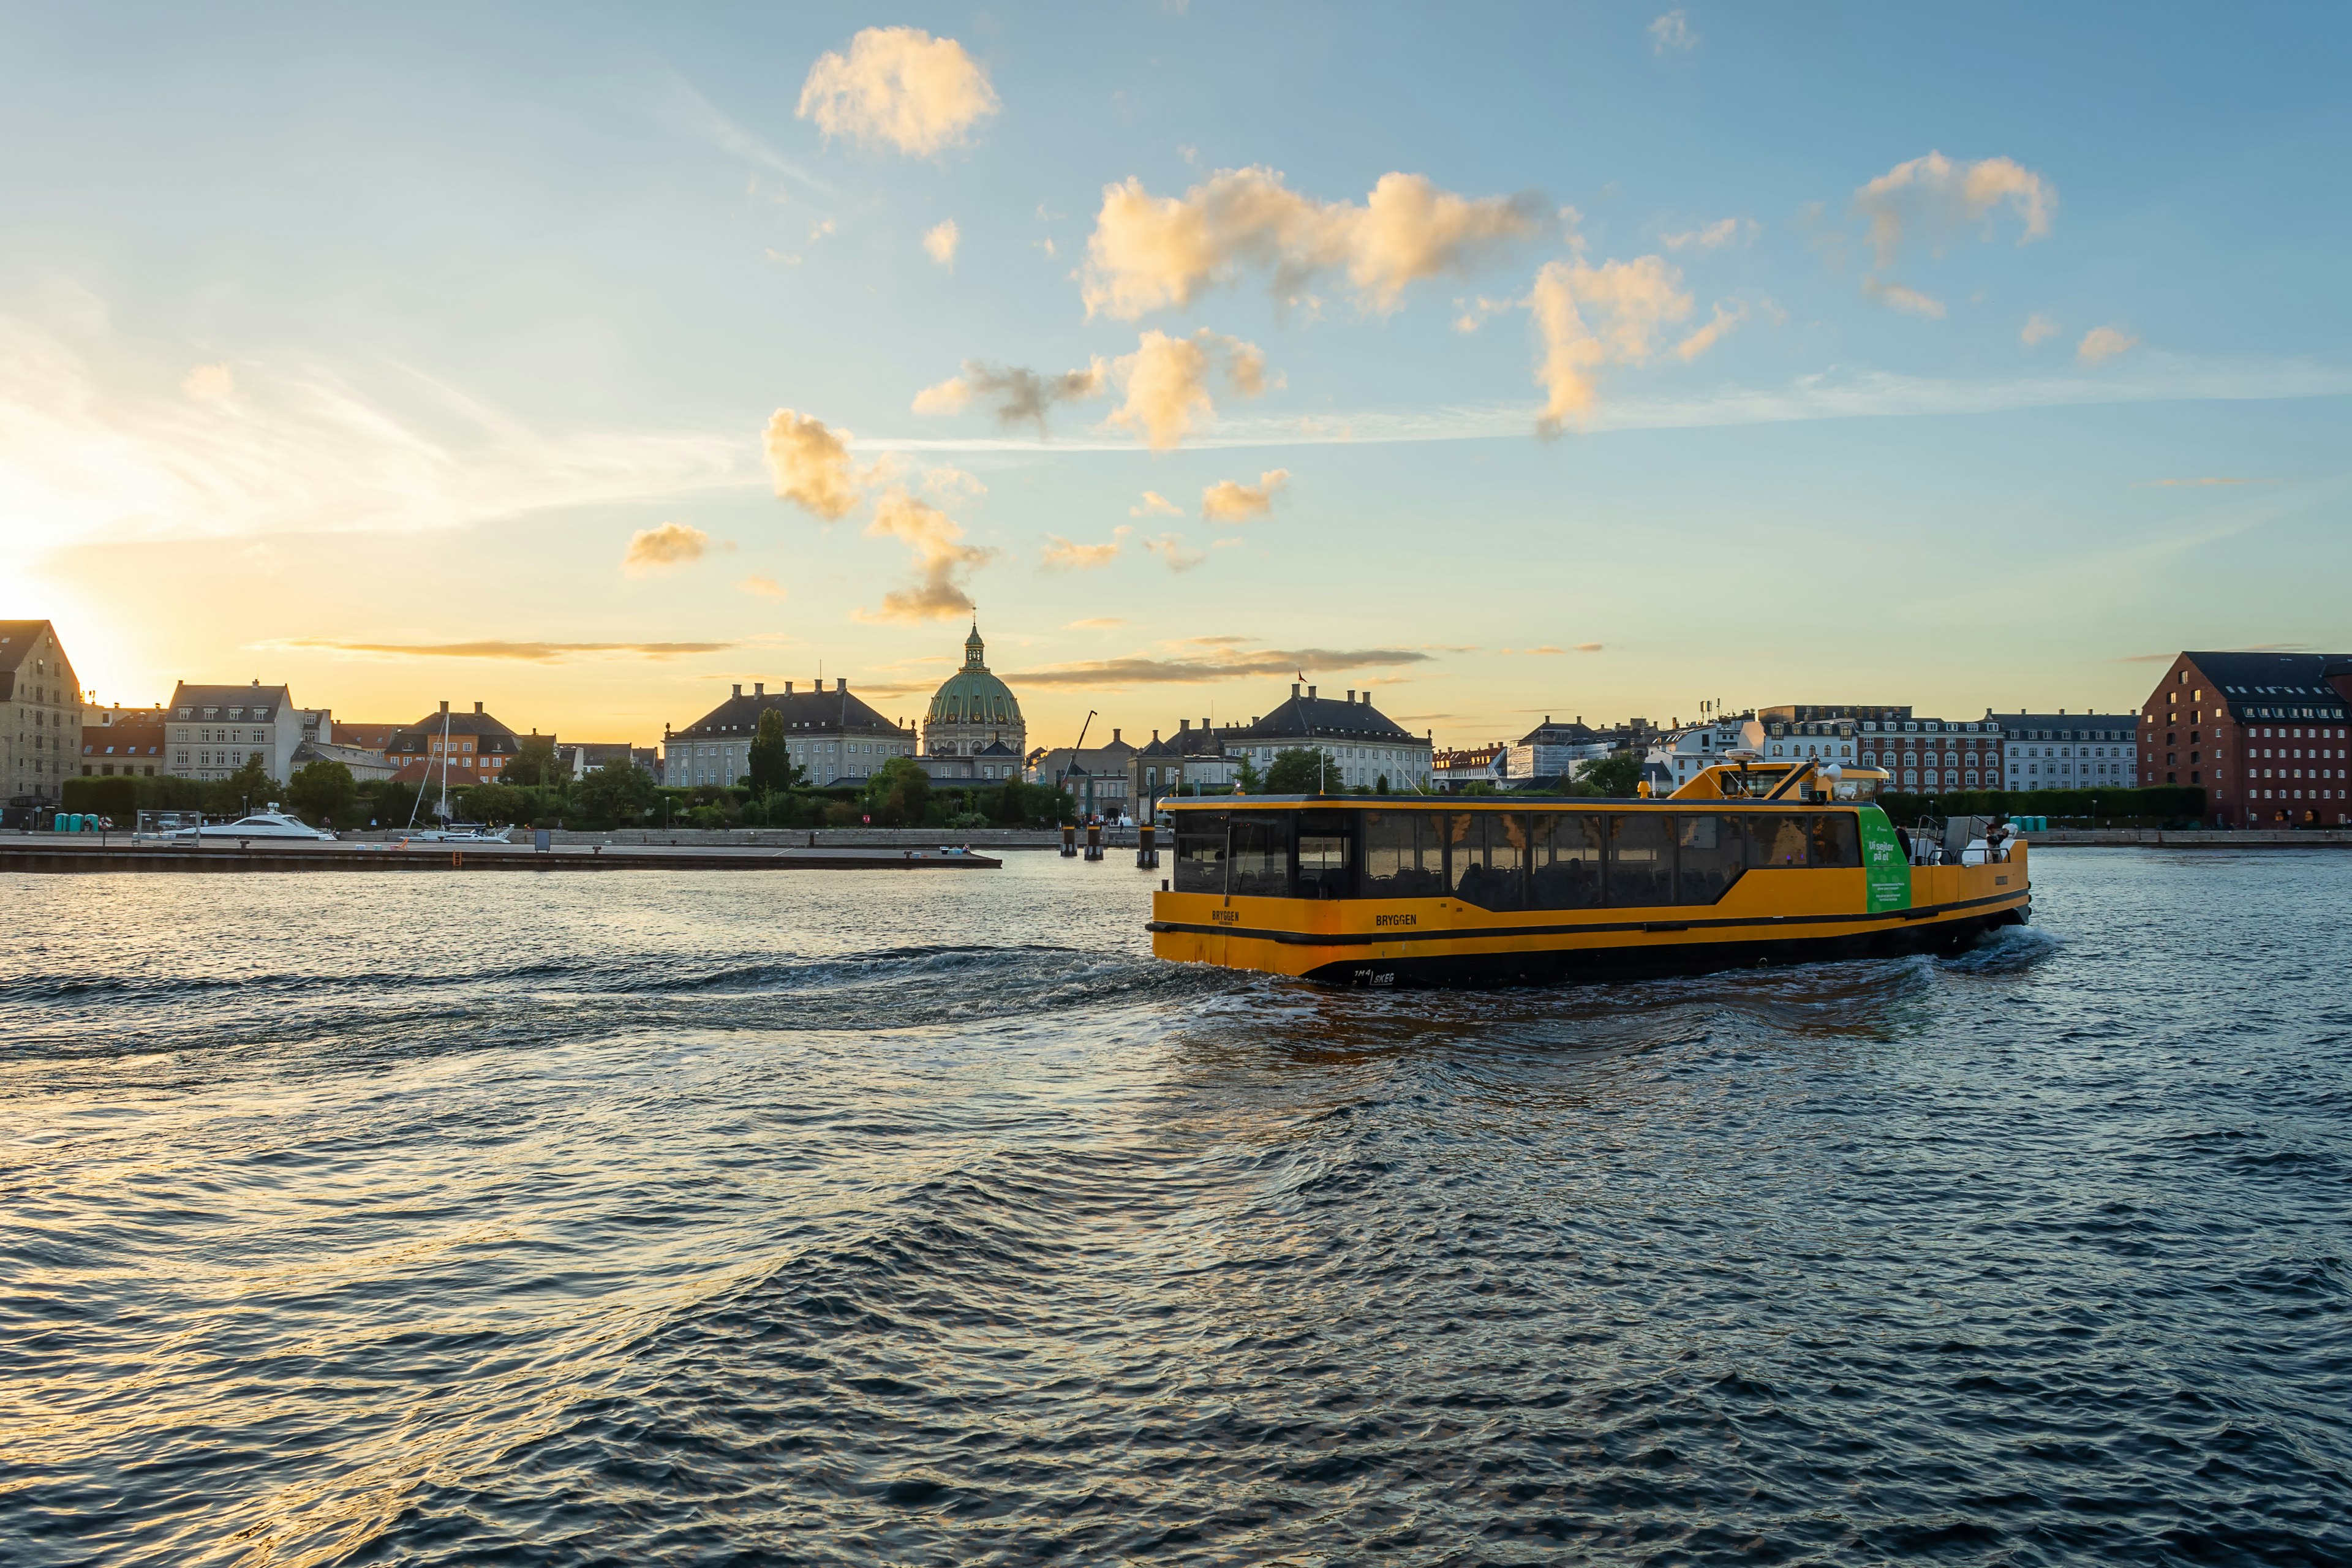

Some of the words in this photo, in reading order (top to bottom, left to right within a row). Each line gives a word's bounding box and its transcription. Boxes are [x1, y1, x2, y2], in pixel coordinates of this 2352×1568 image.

[1869, 841, 1875, 850] Vi
[1876, 842, 1894, 852] sejler
[1874, 851, 1882, 861] på
[1212, 910, 1239, 921] BRYGGEN
[1376, 914, 1416, 926] BRYGGEN
[1374, 973, 1394, 983] SKEG
